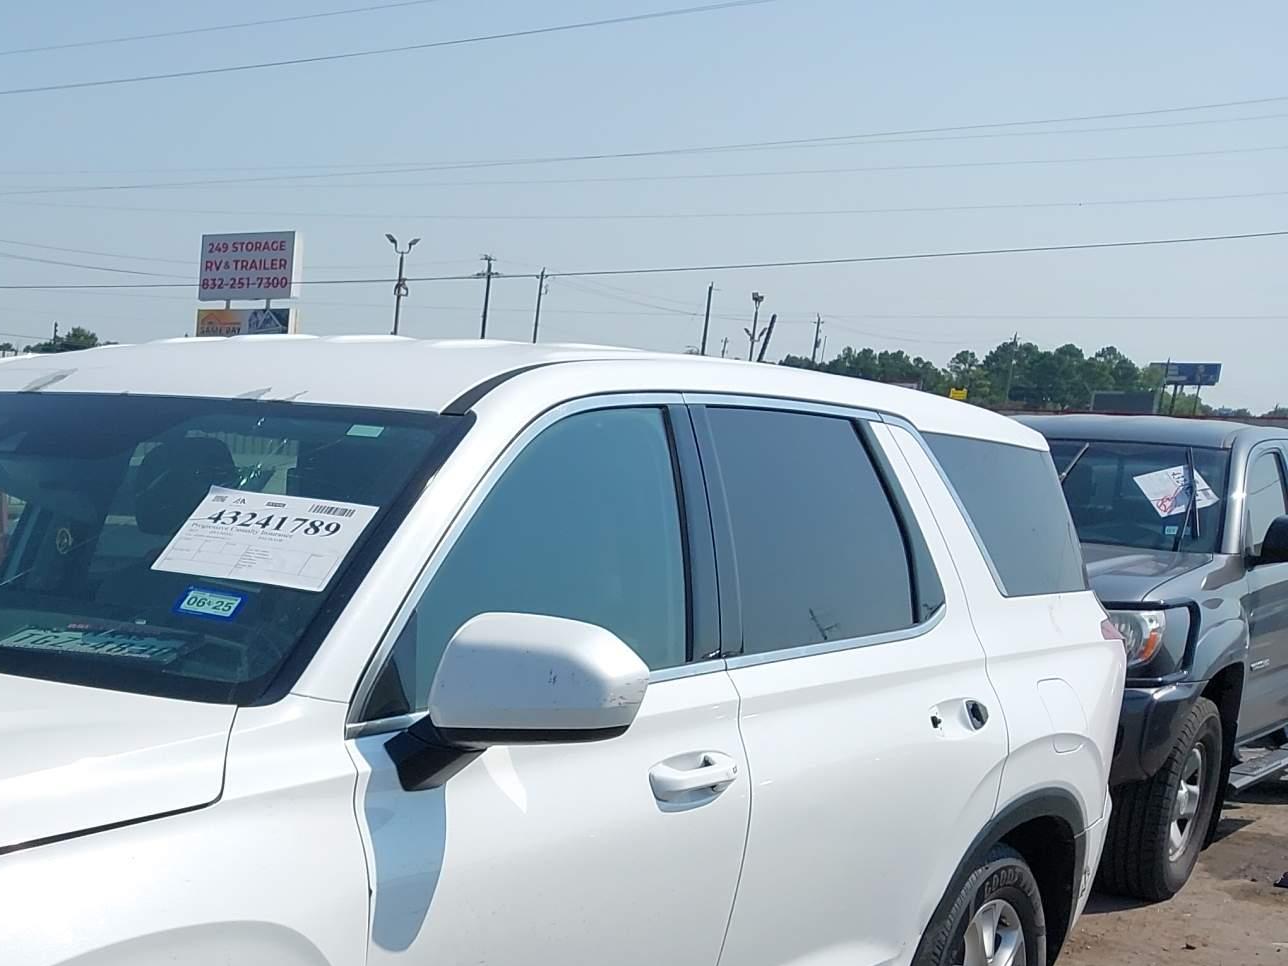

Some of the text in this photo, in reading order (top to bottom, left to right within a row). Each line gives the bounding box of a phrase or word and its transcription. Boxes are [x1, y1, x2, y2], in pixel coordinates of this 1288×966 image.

[208, 240, 286, 254] 249 STORAGE
[205, 259, 223, 272] RV
[233, 258, 287, 271] TRAILER
[202, 276, 288, 290] 832-251-7300
[208, 508, 342, 538] 43241789
[186, 596, 235, 612] 06 25
